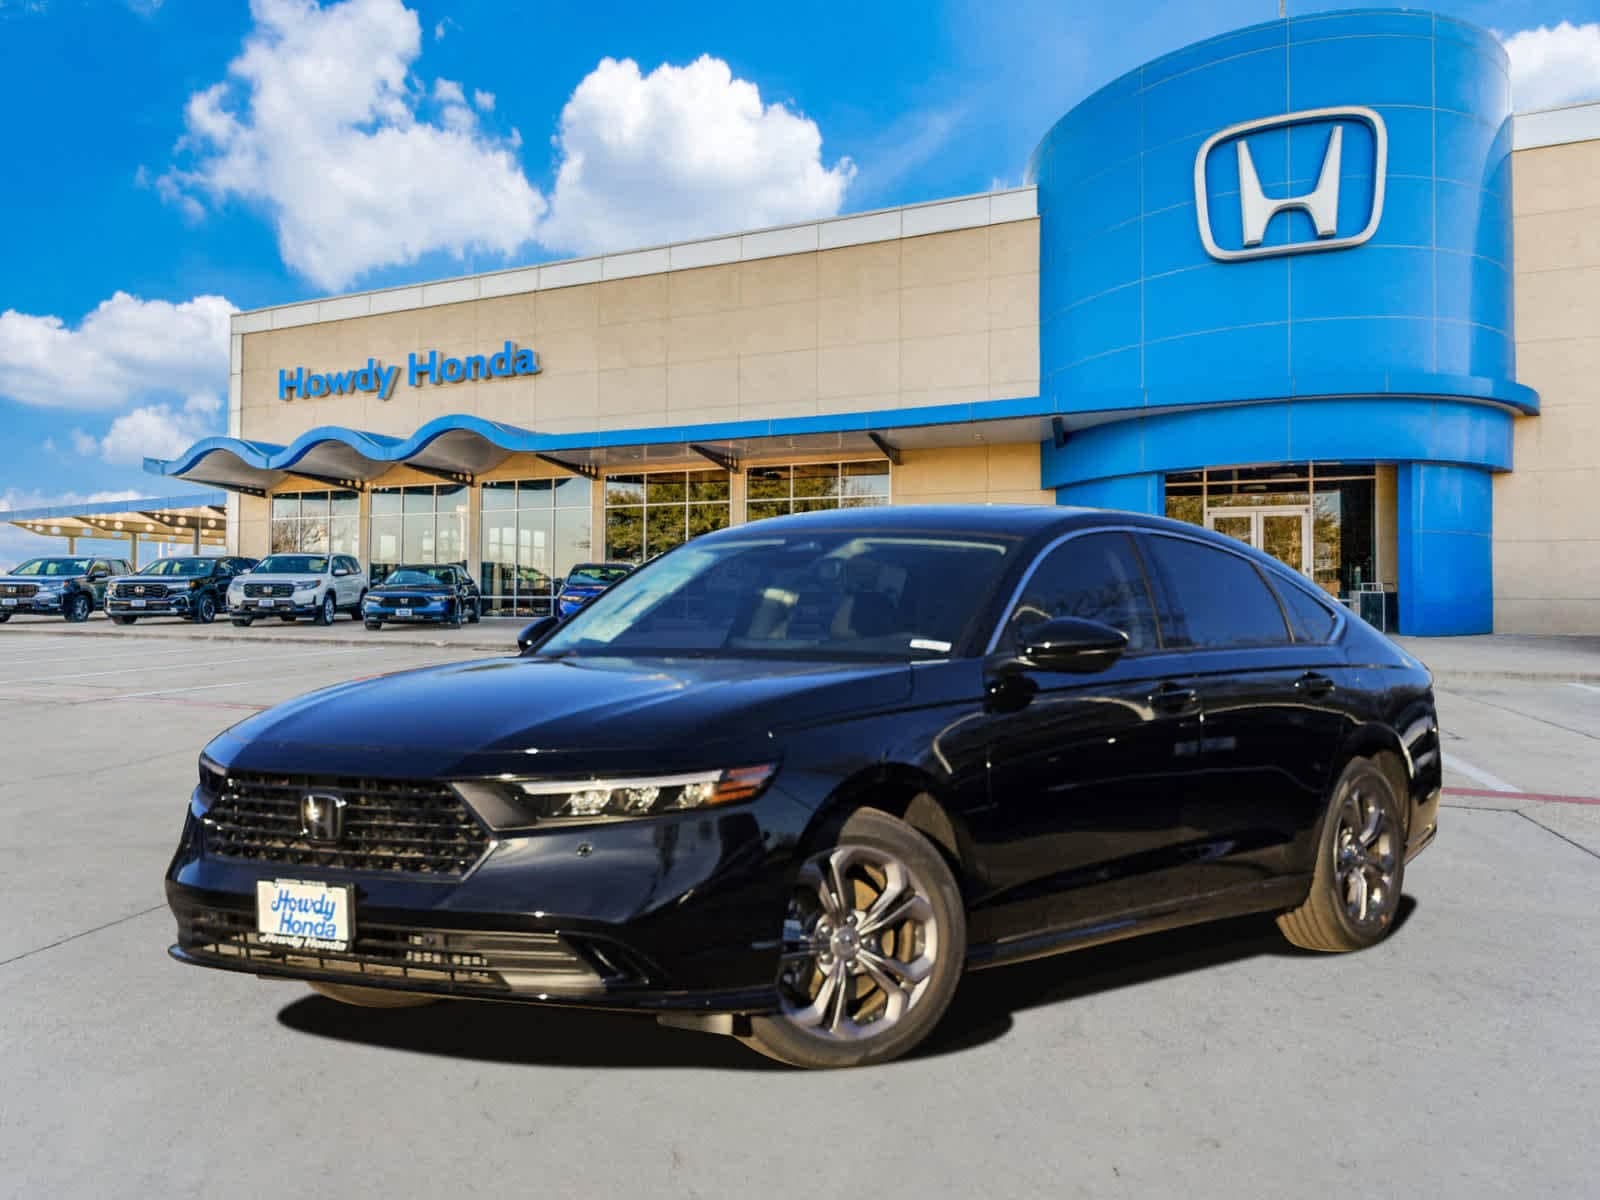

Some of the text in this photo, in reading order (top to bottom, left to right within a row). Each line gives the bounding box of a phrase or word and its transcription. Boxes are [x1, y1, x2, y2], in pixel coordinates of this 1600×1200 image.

[279, 340, 541, 401] Howdy Honda
[271, 889, 336, 921] Howdy
[280, 912, 336, 938] Honda
